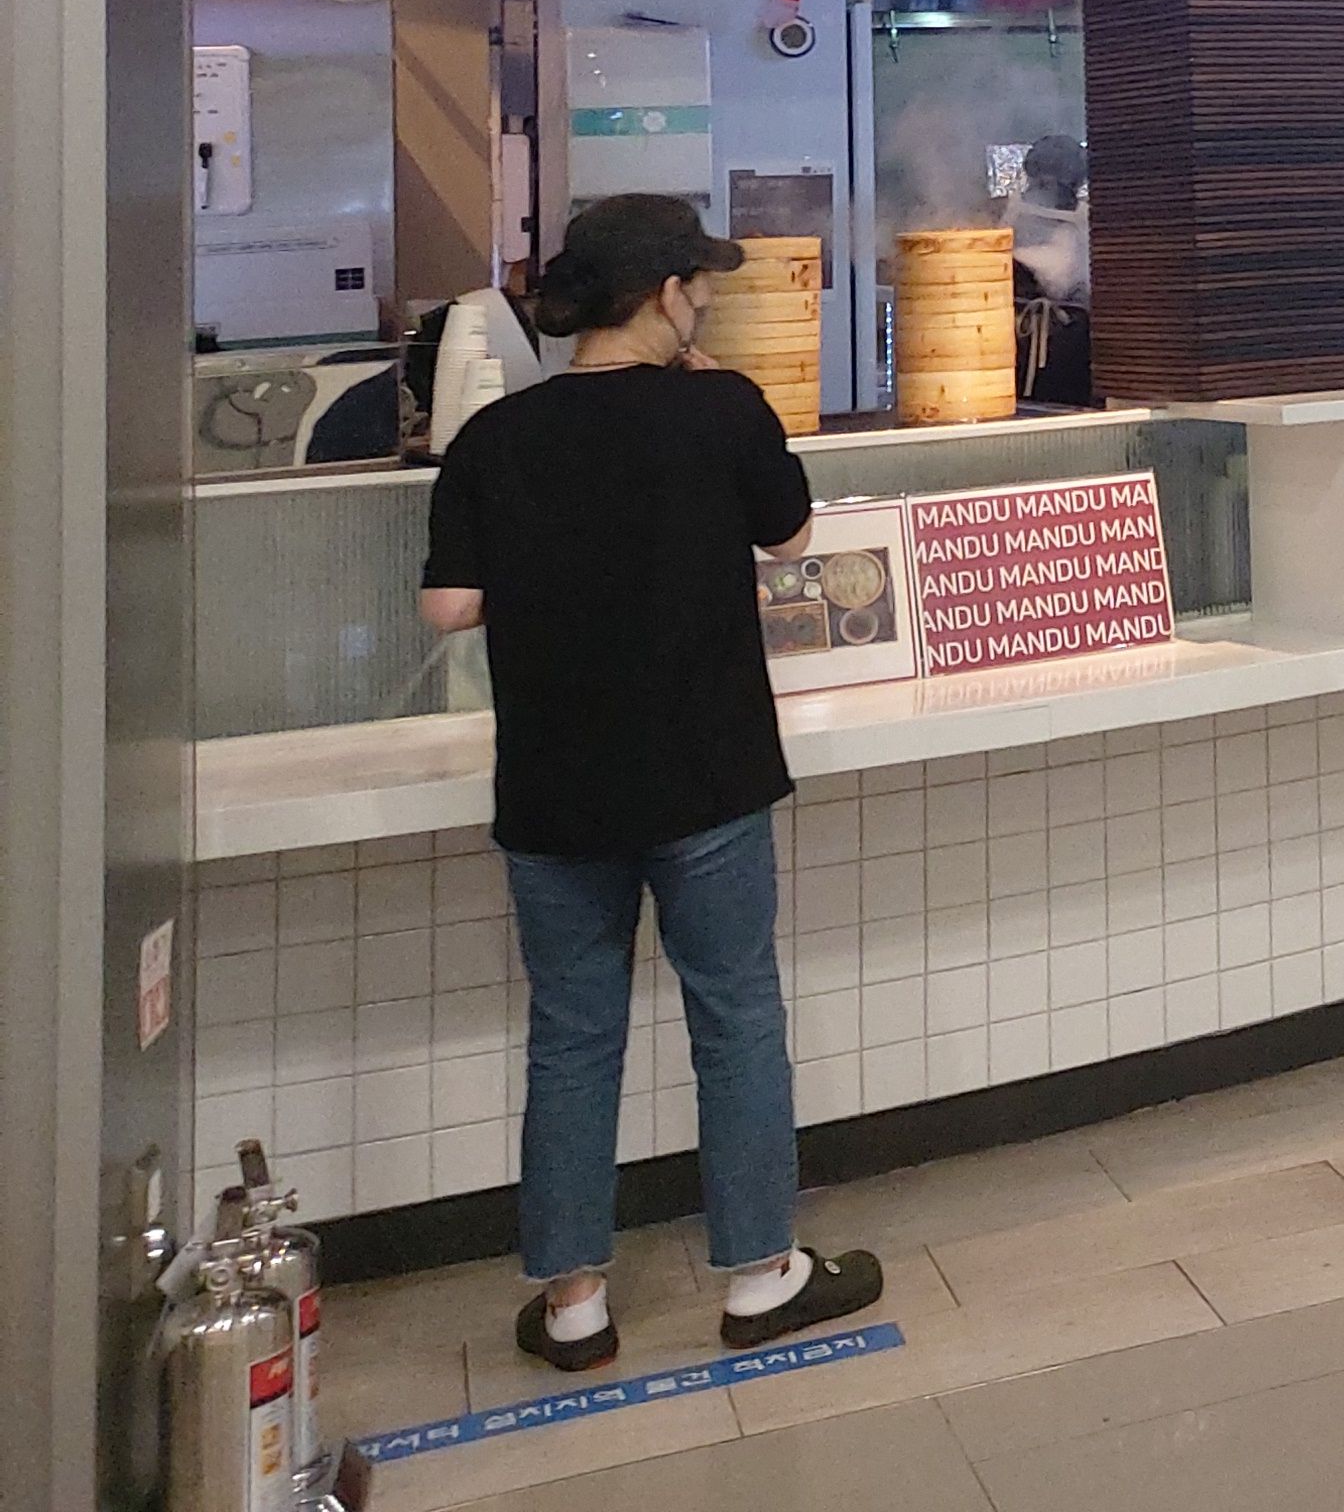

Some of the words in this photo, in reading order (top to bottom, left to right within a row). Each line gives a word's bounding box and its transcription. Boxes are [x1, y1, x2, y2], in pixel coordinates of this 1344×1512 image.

[917, 497, 1011, 529] MANDU
[1016, 487, 1106, 519] MANDU
[1005, 522, 1096, 554] MANDU
[1101, 515, 1155, 543] MAN
[922, 568, 994, 599] ANDU
[999, 555, 1091, 589] MANDU
[1095, 548, 1164, 577] MAND
[996, 589, 1089, 624] MANDU
[1094, 581, 1165, 611] MAND
[927, 639, 983, 668] NDU
[988, 625, 1081, 660] MANDU
[1086, 613, 1173, 646] MANDU
[483, 1386, 625, 1431] 설치지역
[732, 1335, 867, 1374] 적치금지
